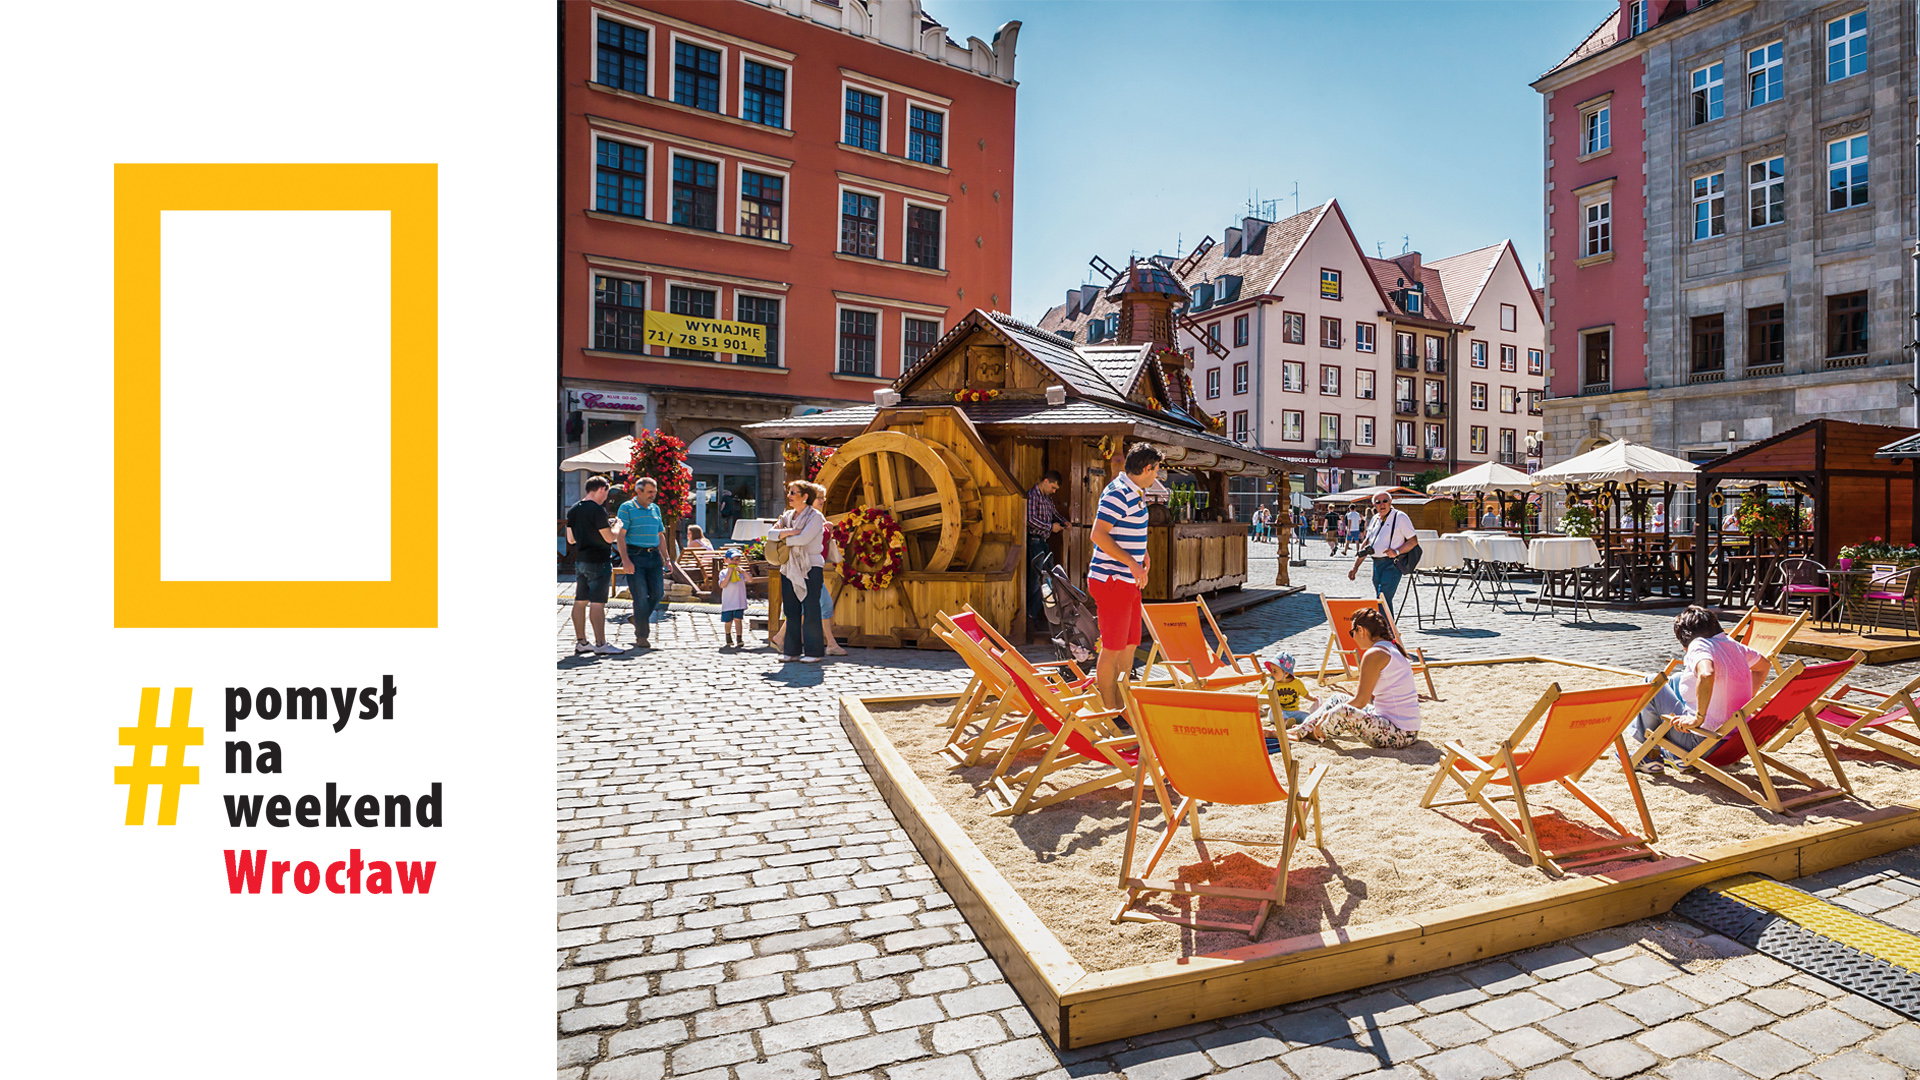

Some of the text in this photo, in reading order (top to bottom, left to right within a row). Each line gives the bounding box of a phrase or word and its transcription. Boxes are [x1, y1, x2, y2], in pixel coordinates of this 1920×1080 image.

[648, 330, 674, 344] 71/
[680, 333, 697, 345] 78
[702, 336, 718, 347] 51
[686, 320, 760, 341] WYNAJMĘ
